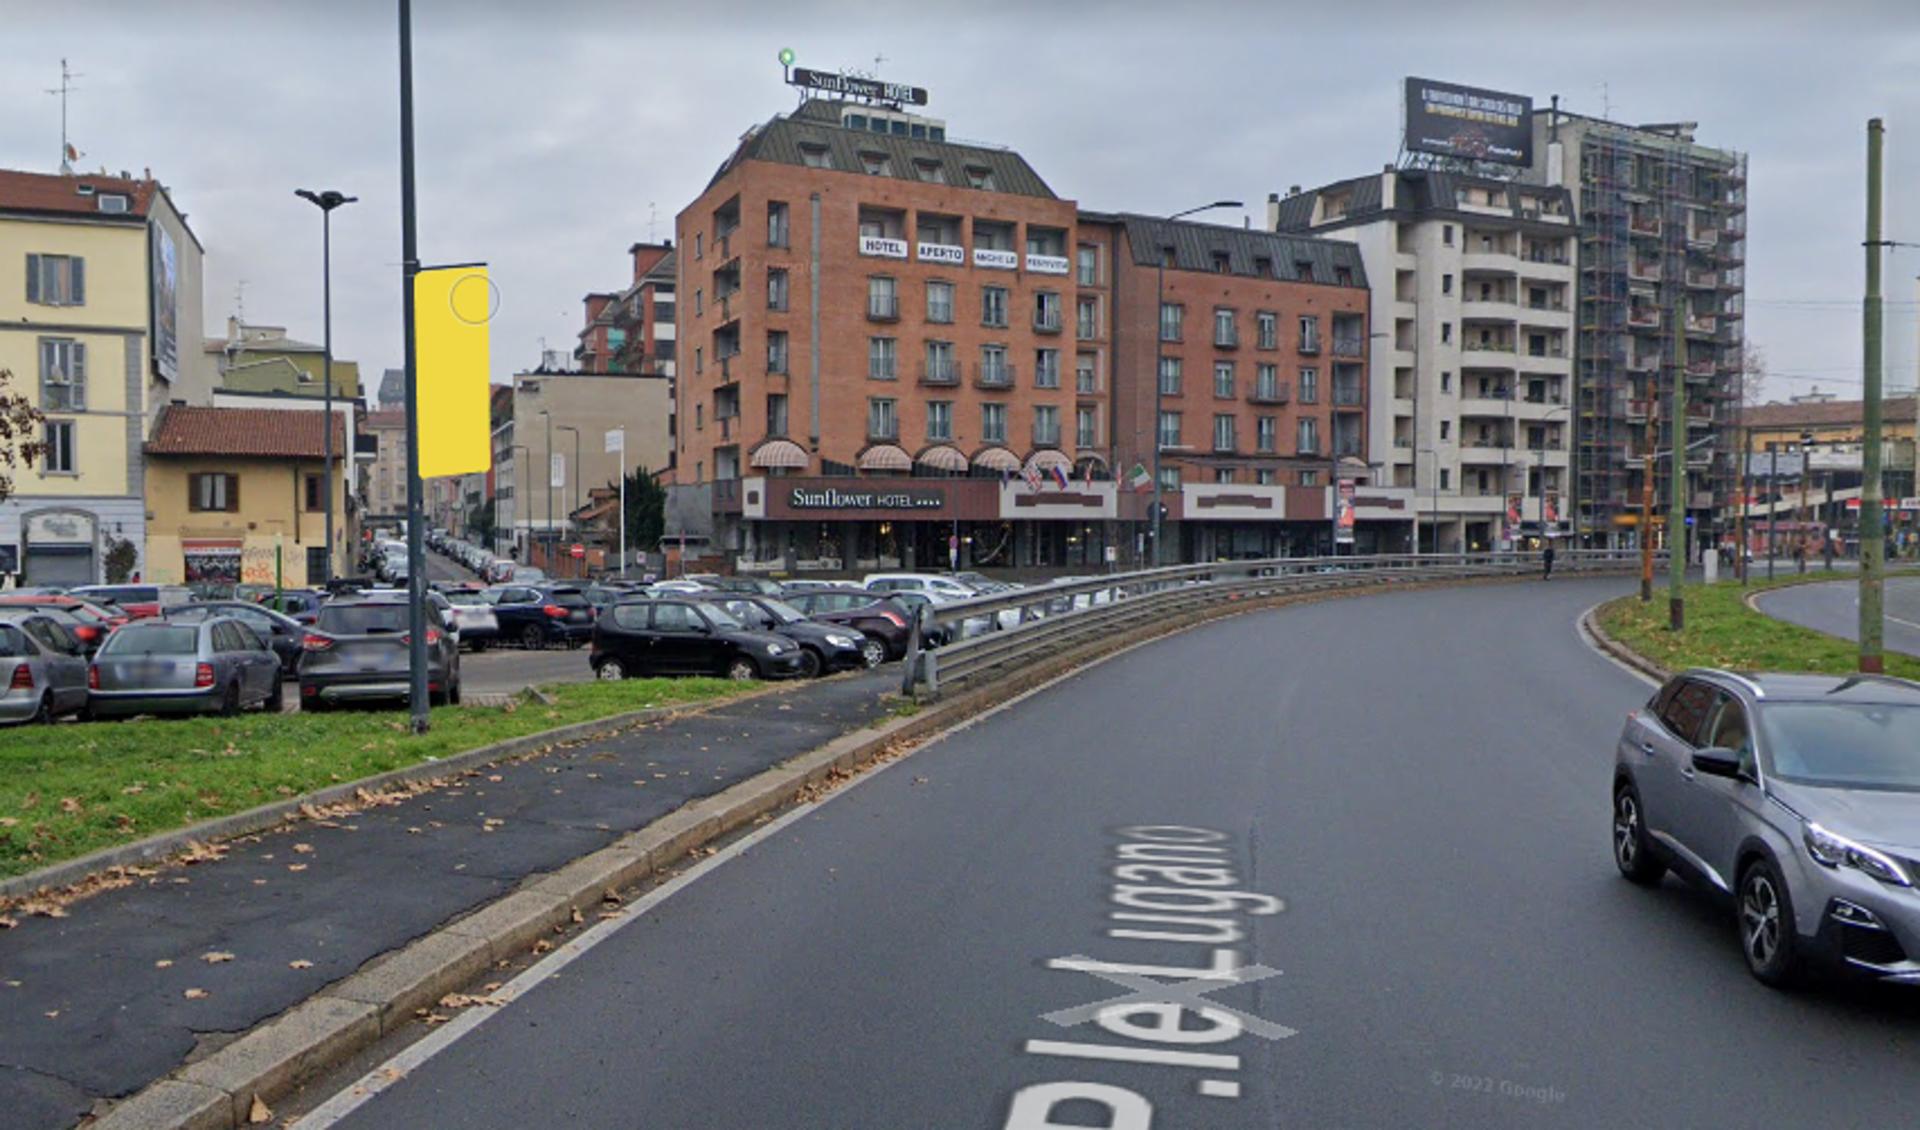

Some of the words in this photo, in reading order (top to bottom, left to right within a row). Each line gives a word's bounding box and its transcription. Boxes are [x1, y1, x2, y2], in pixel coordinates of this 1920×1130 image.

[809, 70, 878, 97] Sunflower
[883, 83, 915, 103] HOTEL
[866, 240, 901, 253] HOTEL
[919, 246, 962, 260] APERTO
[793, 487, 872, 507] Sunflower
[877, 494, 914, 507] HOTEL
